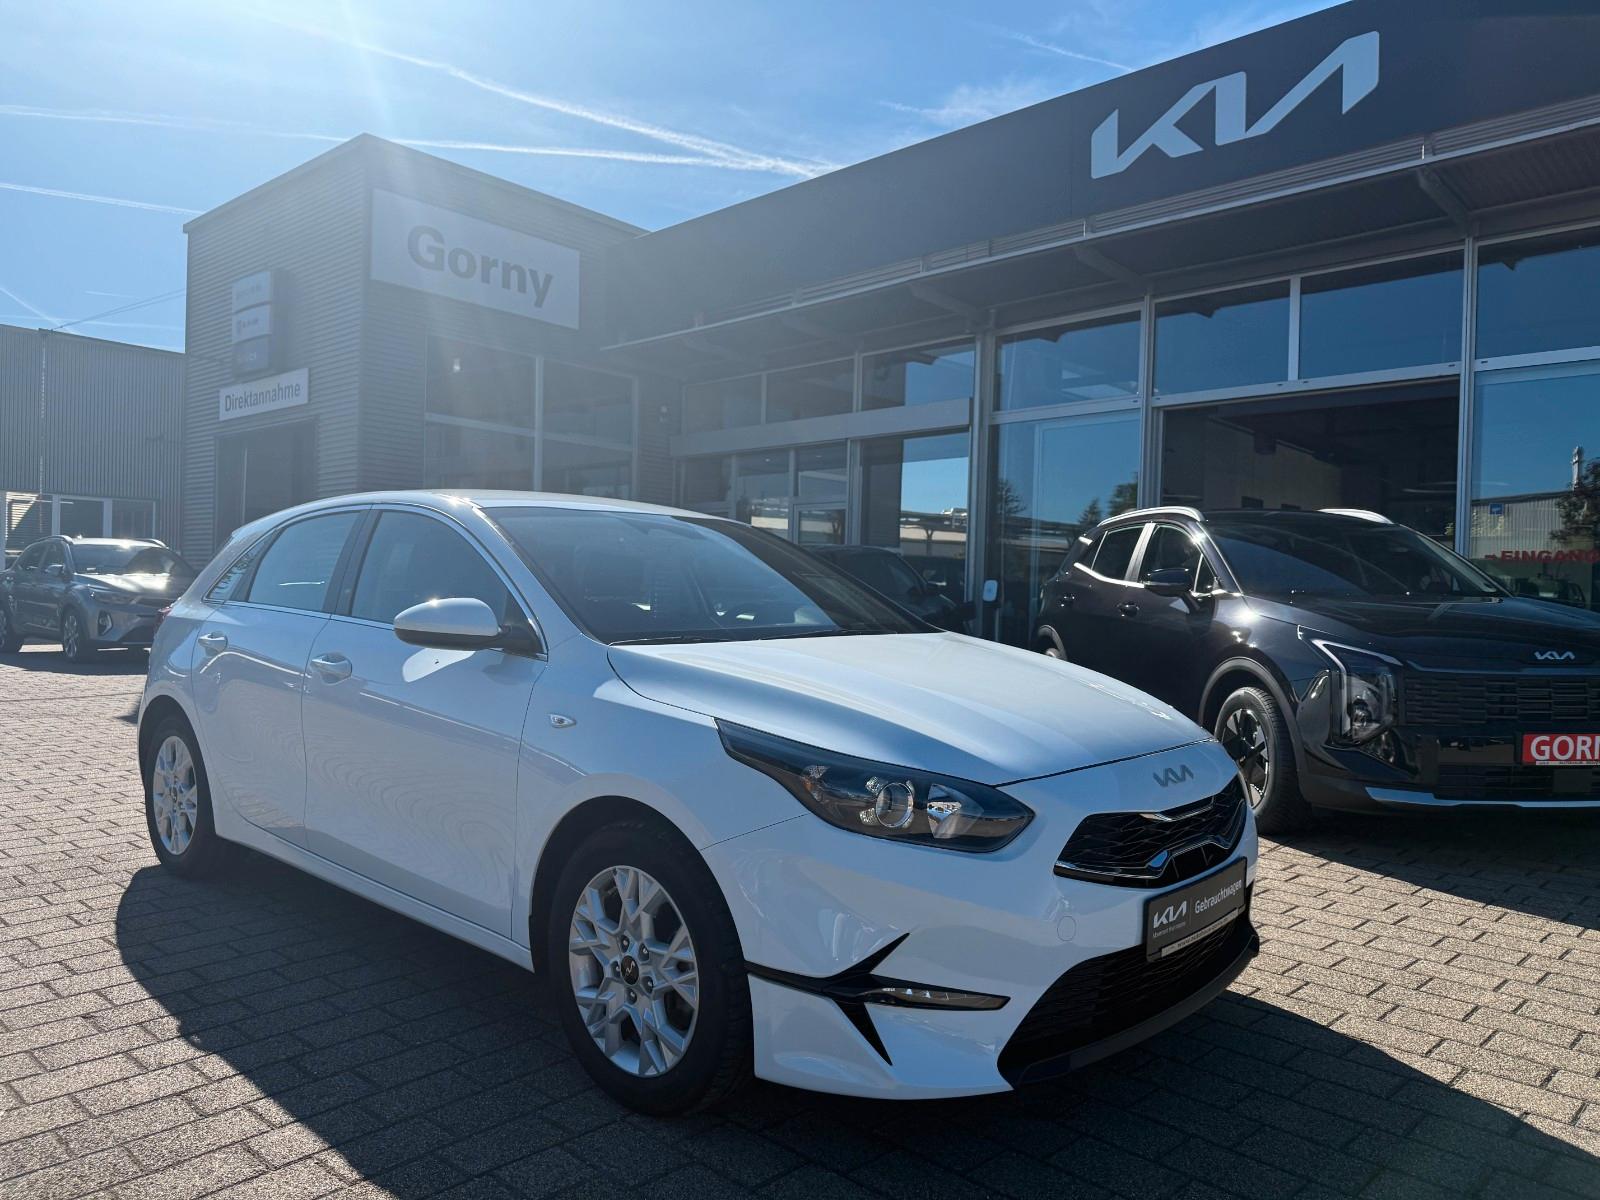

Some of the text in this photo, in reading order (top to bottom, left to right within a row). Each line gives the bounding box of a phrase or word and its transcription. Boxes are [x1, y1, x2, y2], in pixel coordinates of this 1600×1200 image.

[1091, 31, 1380, 179] KIA
[407, 225, 553, 308] Gorny
[225, 383, 301, 412] Direktannahme
[1534, 651, 1576, 660] KIA
[1153, 764, 1194, 787] KIA
[1153, 879, 1242, 929] KIA Gebrauchtwagen
